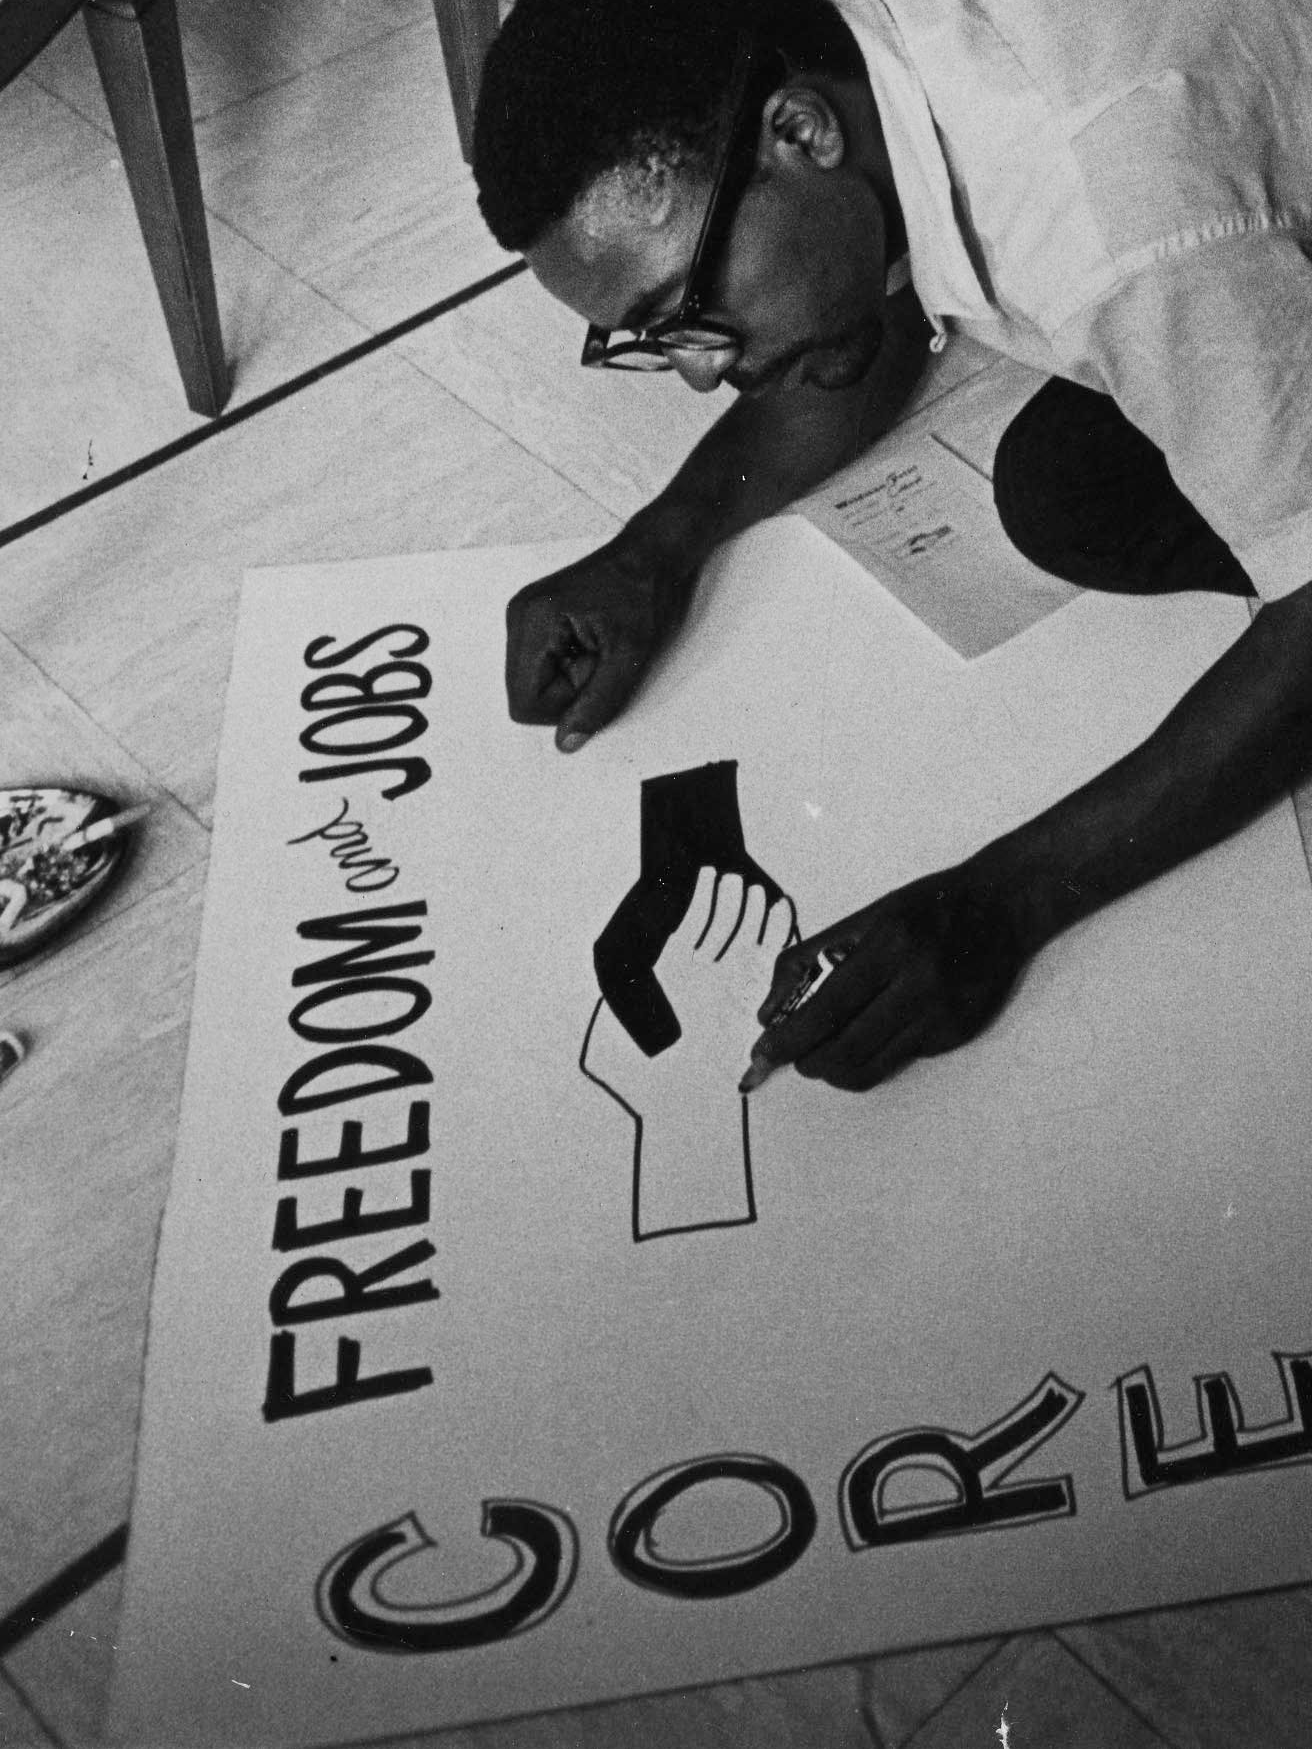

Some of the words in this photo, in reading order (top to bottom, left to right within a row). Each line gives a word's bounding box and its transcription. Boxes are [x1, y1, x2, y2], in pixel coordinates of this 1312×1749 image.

[298, 622, 434, 802] JOBS
[287, 797, 400, 893] and
[262, 899, 441, 1424] FREEDOM
